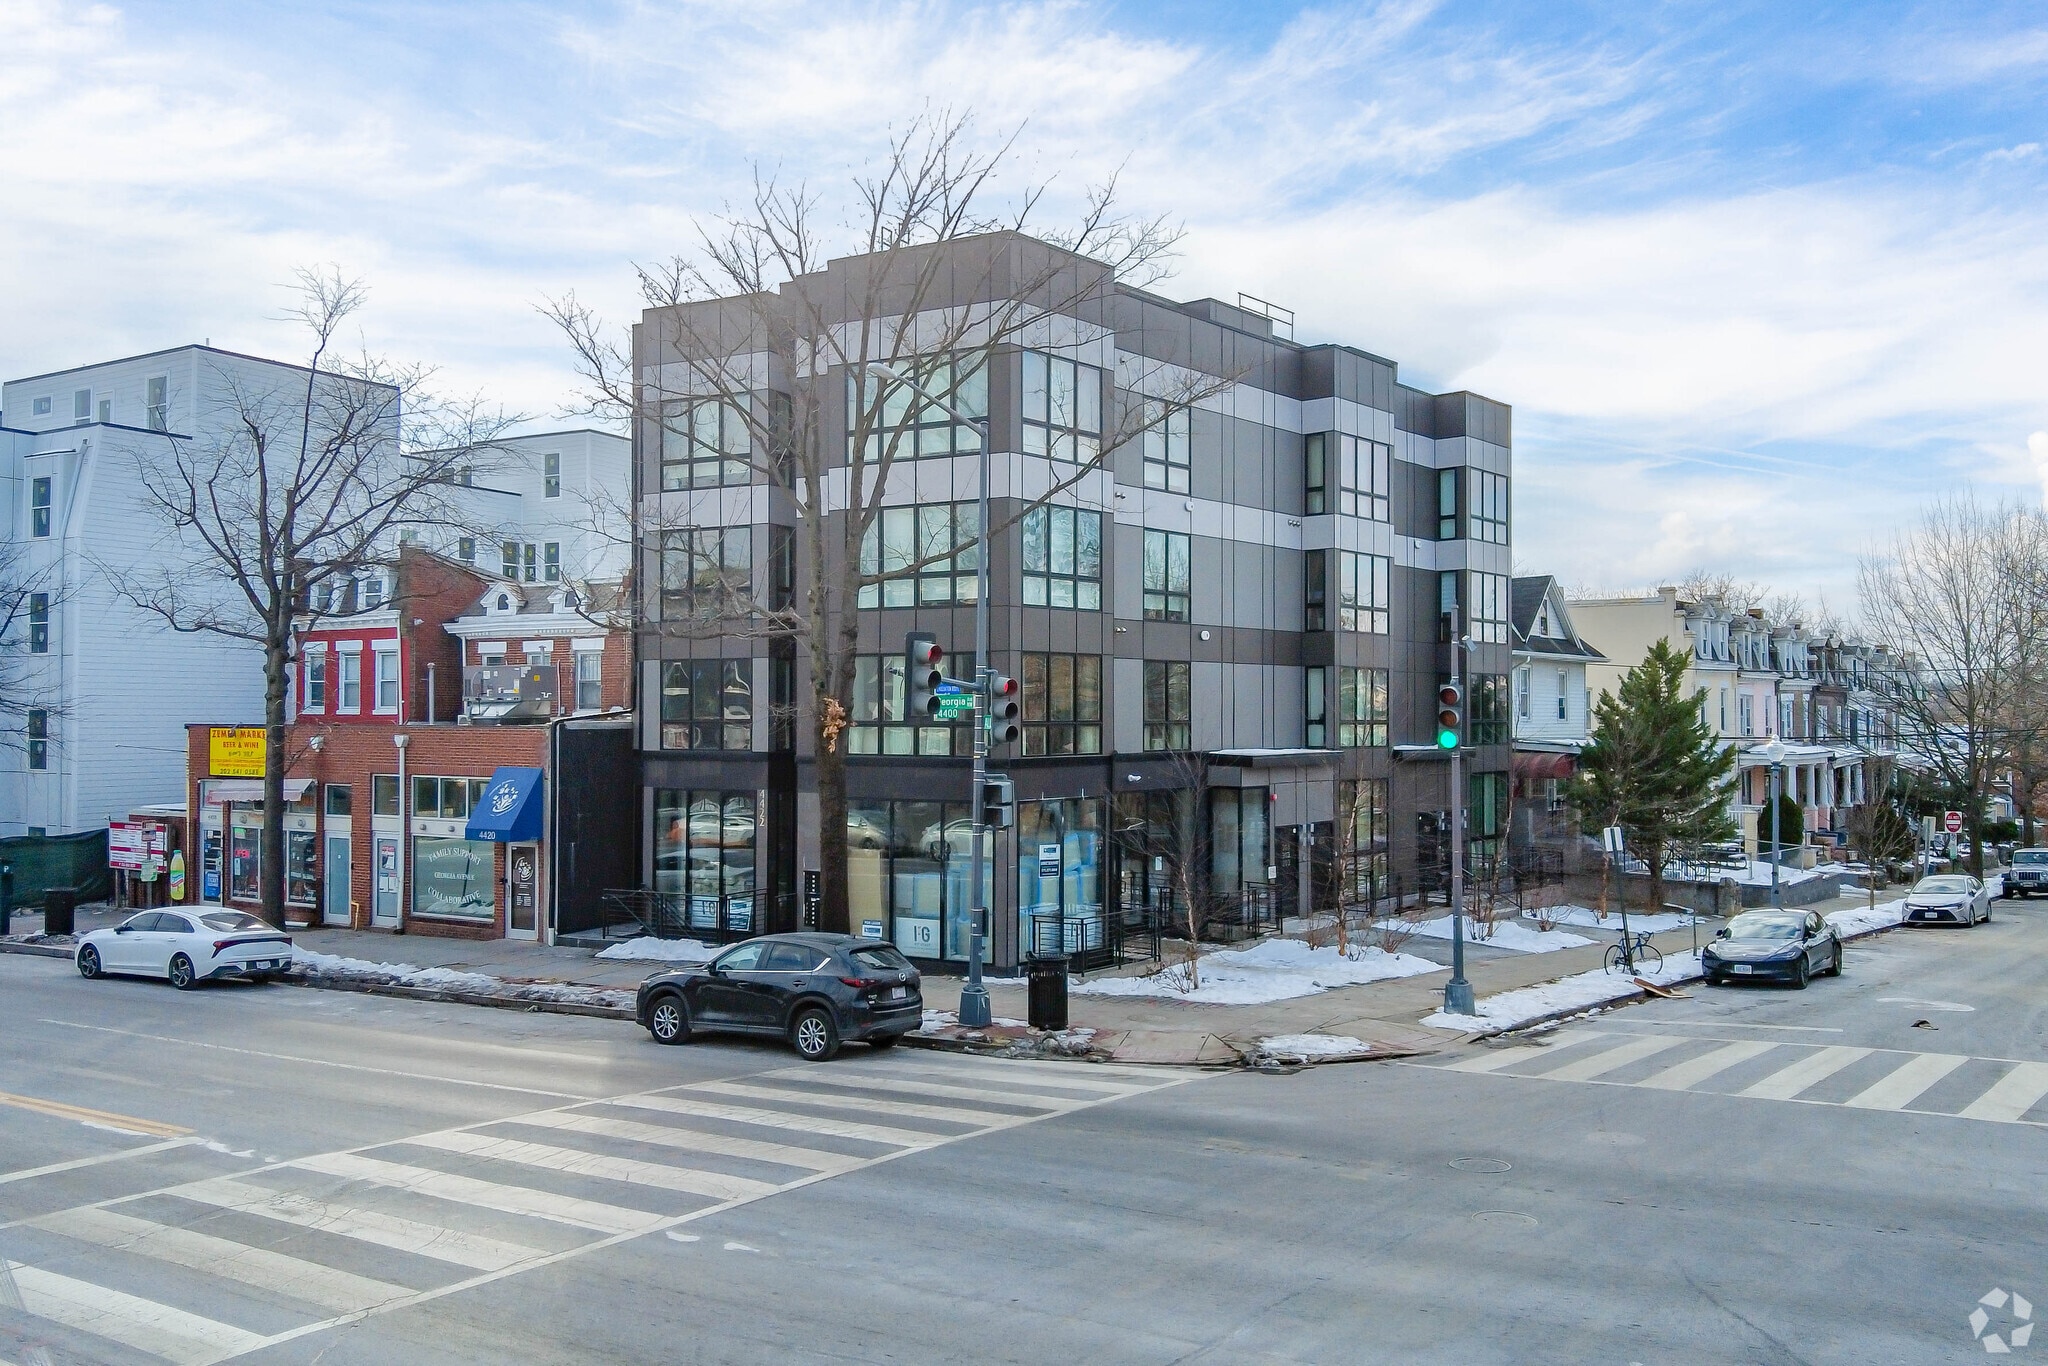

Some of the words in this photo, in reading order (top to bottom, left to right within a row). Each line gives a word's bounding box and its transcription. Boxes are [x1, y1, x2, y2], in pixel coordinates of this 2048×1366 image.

[940, 697, 966, 708] eorgia
[938, 709, 958, 718] 4400
[240, 730, 266, 738] MARKE
[478, 831, 496, 840] 4420
[428, 847, 453, 862] FAMILY
[453, 847, 481, 865] SUPPORT
[428, 887, 481, 905] COLLABORATIVE
